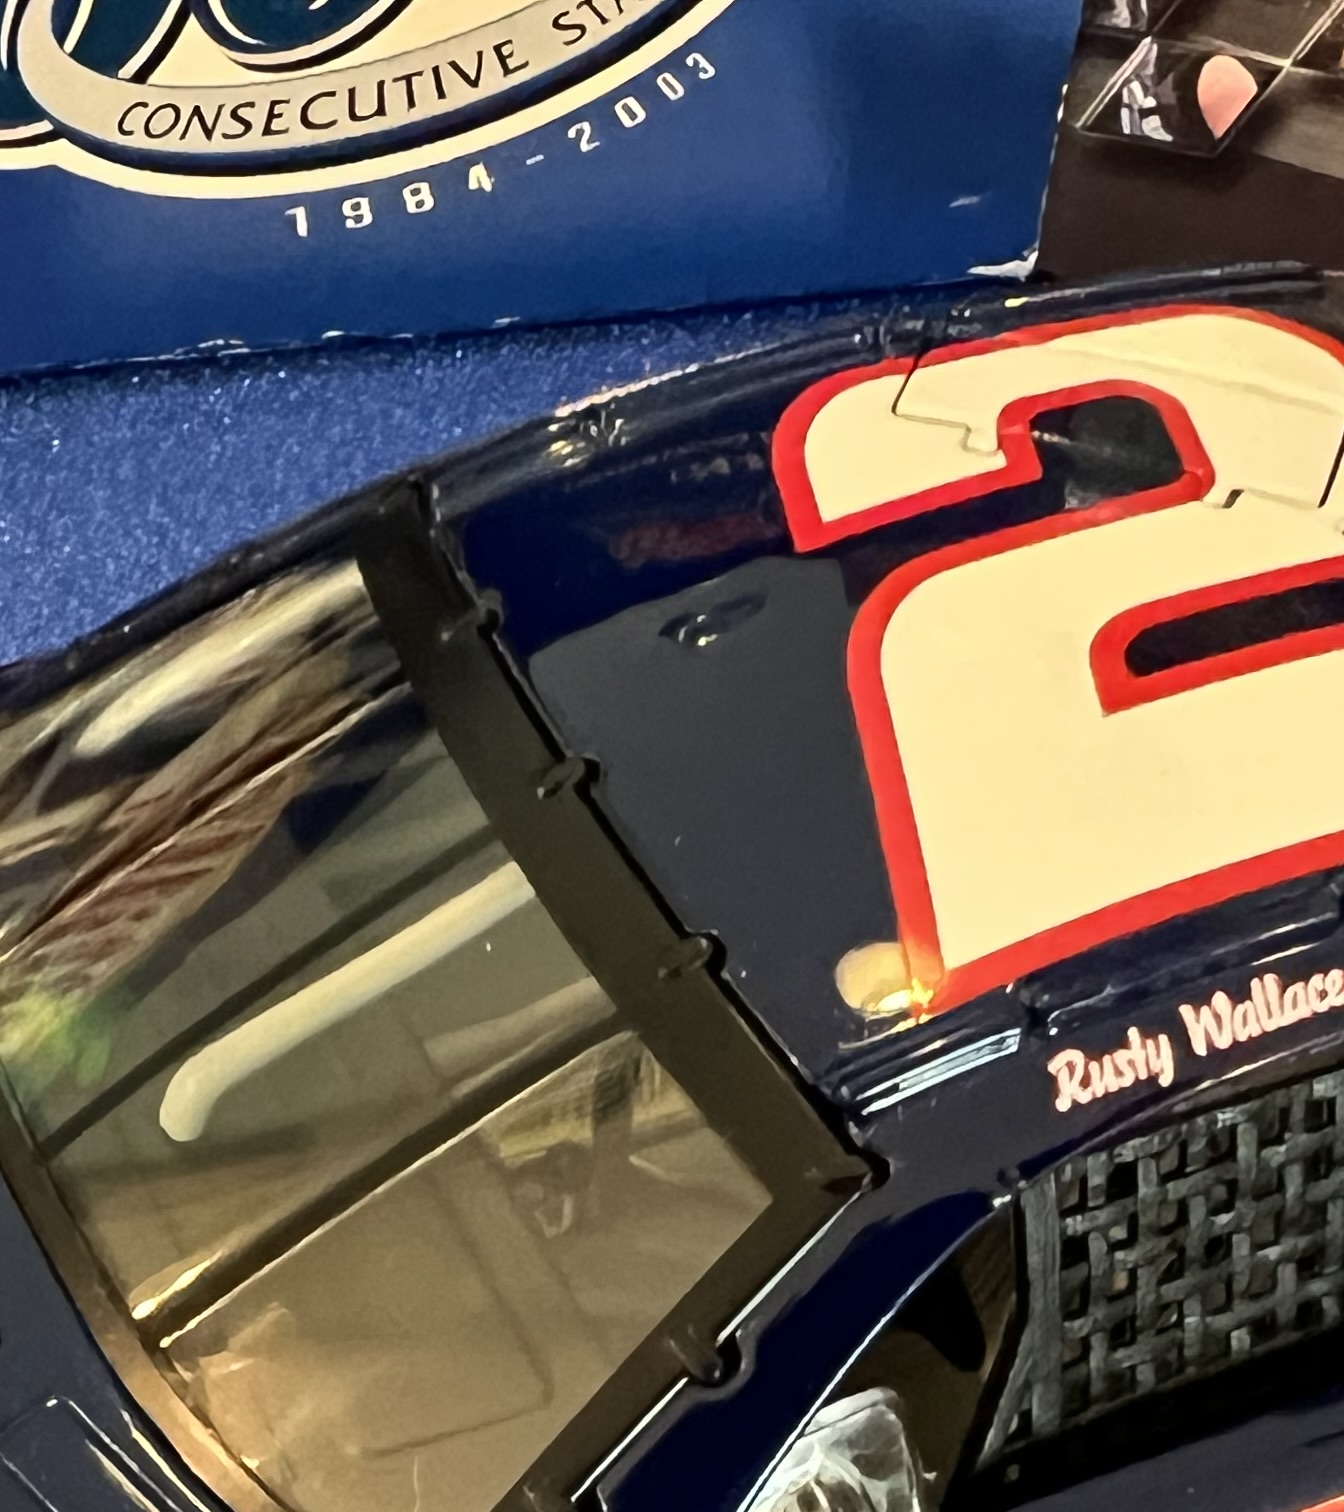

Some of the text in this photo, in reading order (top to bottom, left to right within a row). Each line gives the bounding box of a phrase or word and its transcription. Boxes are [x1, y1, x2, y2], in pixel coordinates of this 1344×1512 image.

[117, 0, 642, 142] CONSECUTIVE ST
[285, 52, 716, 237] 1984-2003
[1048, 1026, 1175, 1112] Rusty
